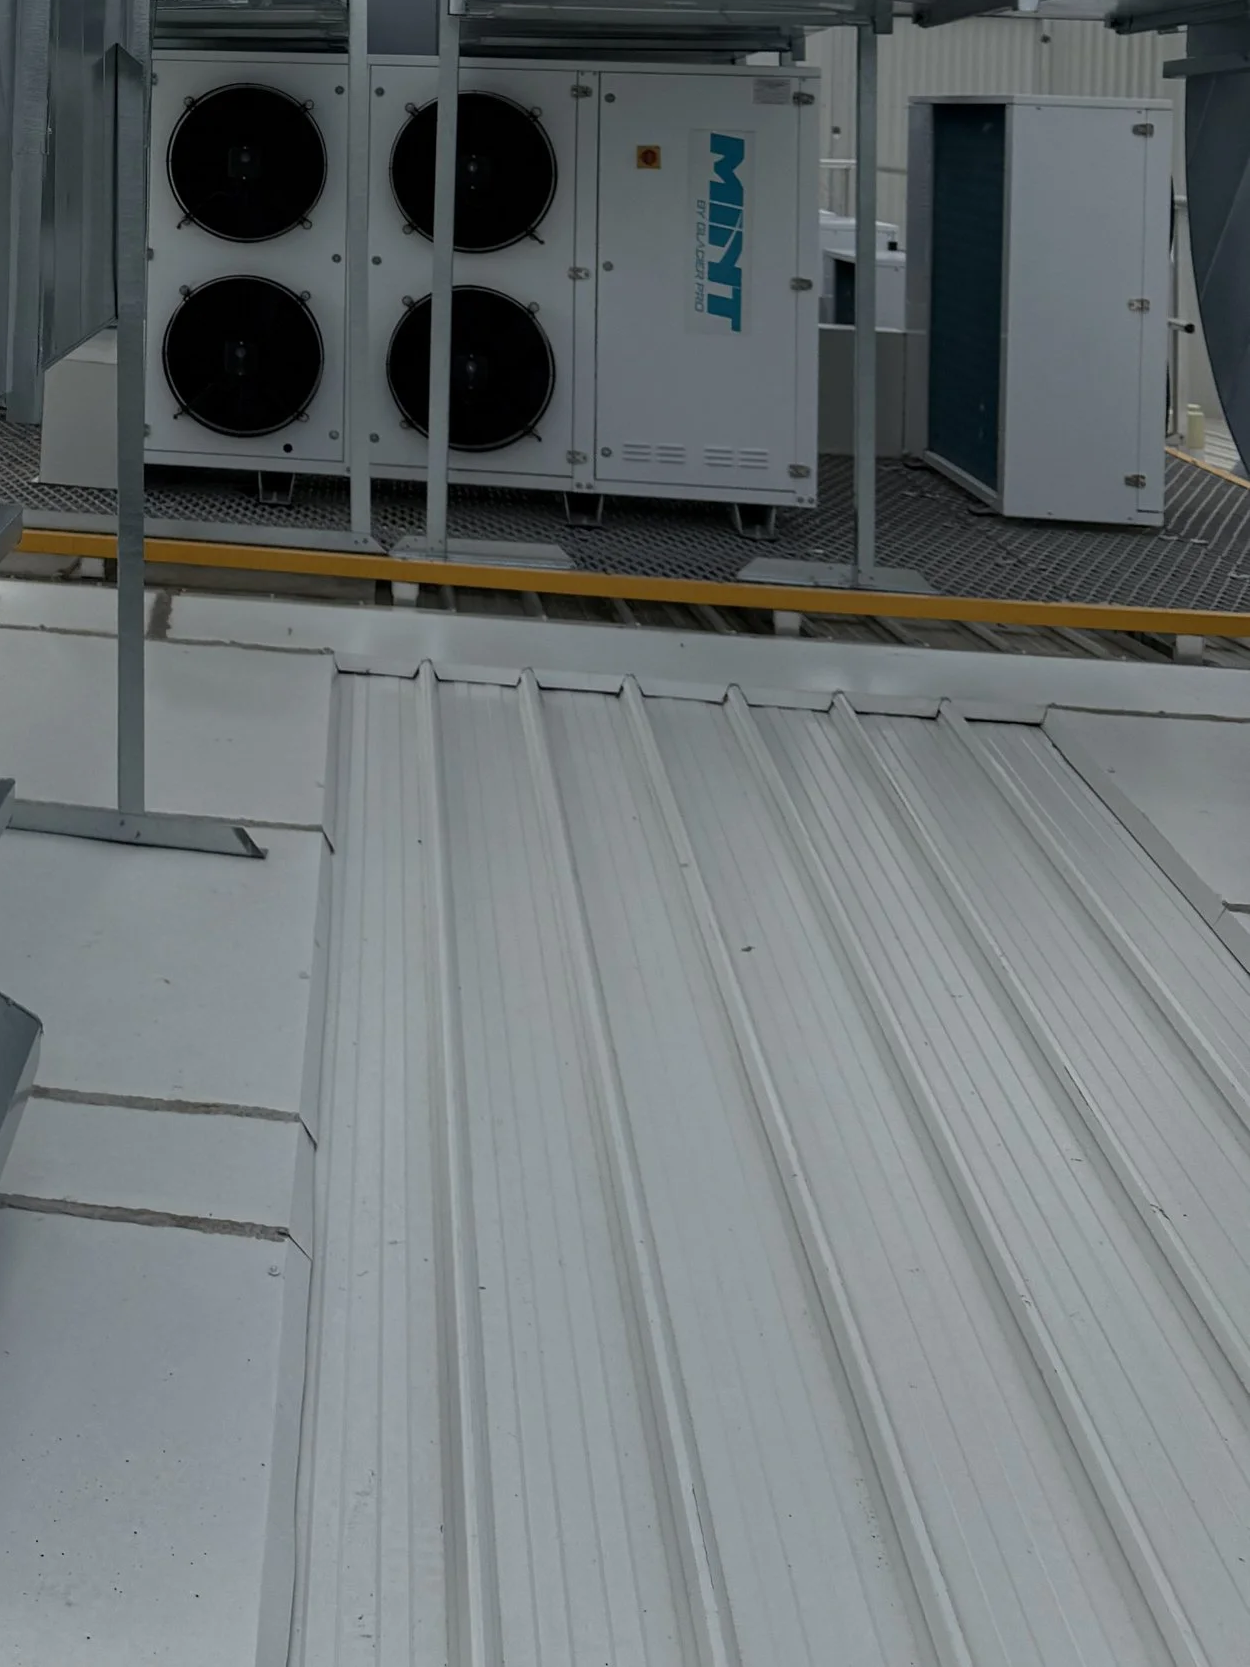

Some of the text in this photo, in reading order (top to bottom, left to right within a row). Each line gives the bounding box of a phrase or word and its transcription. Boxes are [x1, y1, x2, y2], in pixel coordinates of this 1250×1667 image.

[696, 199, 706, 219] BY
[707, 133, 745, 332] MINT
[694, 282, 705, 312] PRO
